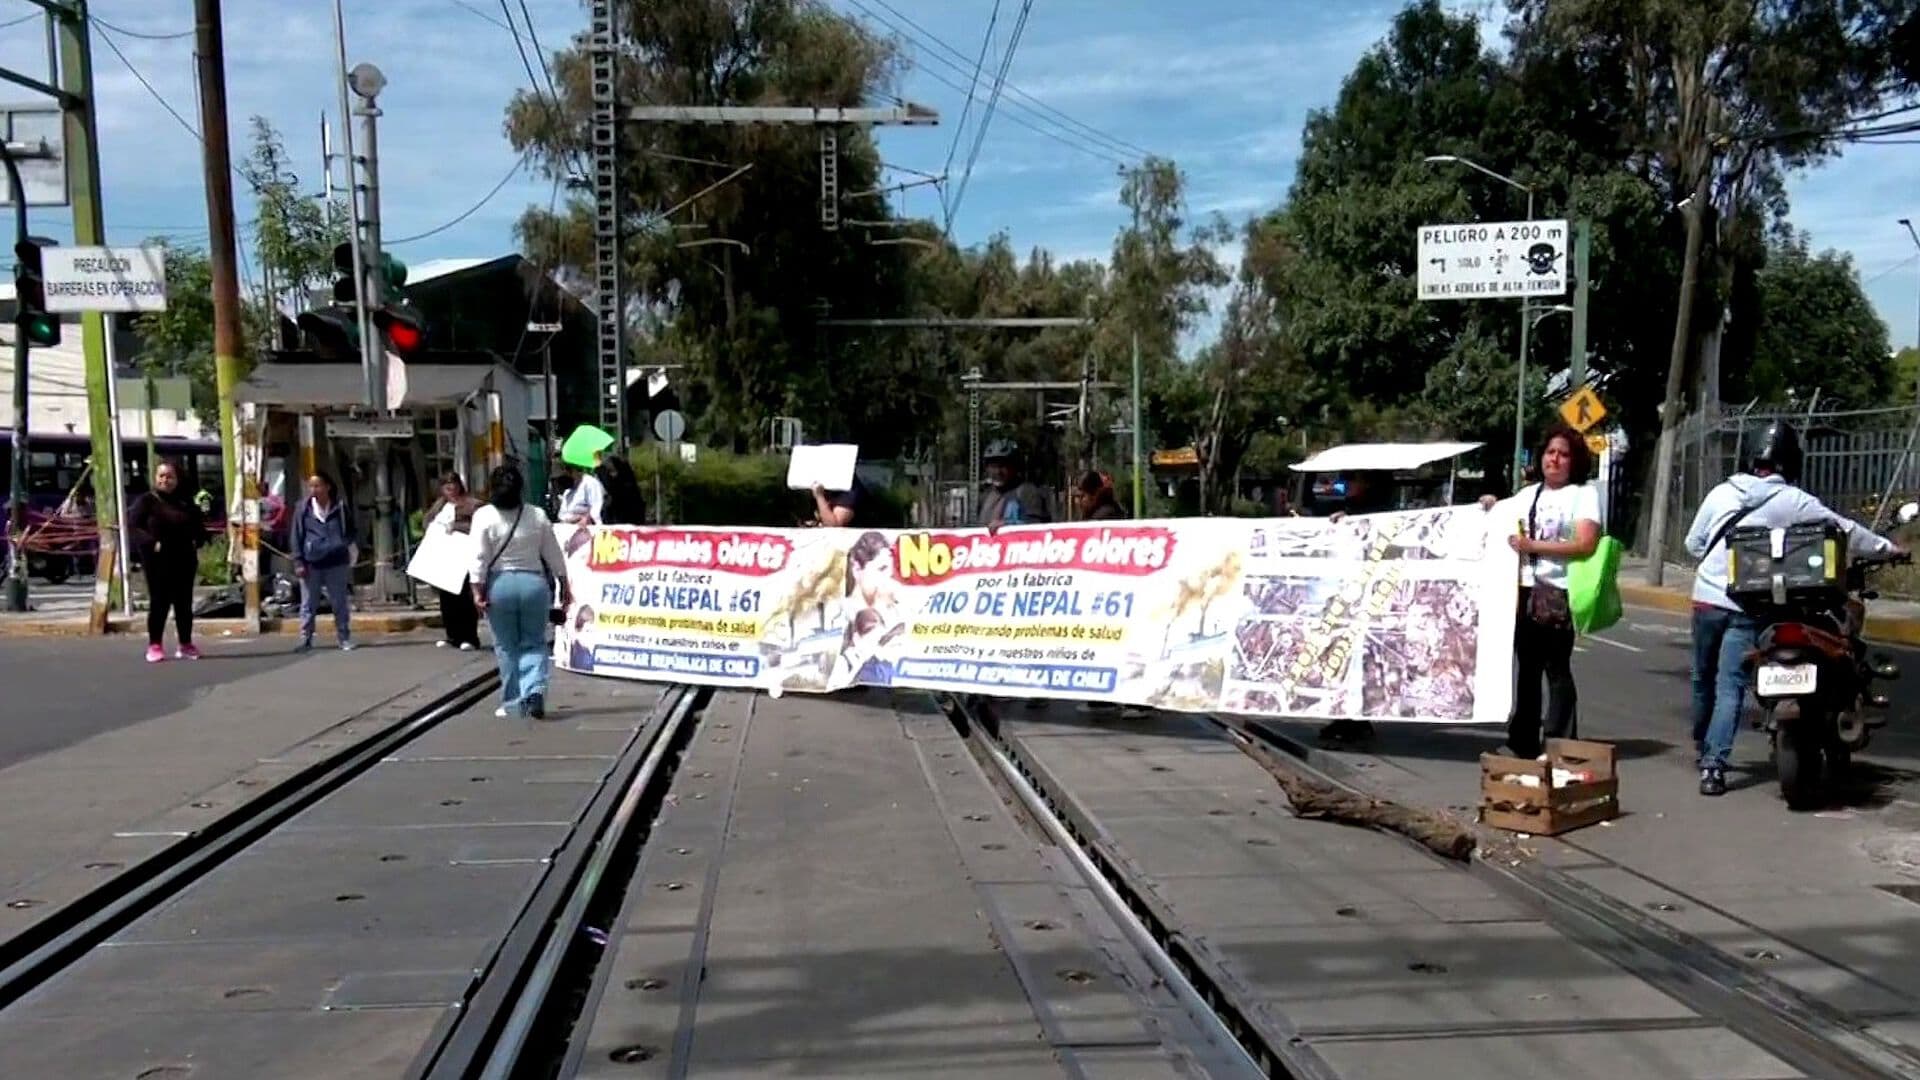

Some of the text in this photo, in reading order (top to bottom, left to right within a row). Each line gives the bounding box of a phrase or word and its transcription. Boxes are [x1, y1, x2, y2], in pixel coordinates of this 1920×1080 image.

[1424, 226, 1562, 244] PELIGRO A 200 m
[47, 282, 94, 296] BARRERAS
[97, 281, 109, 296] EN
[1489, 281, 1498, 292] DE
[1503, 281, 1523, 291] ALTA
[593, 529, 620, 565] No
[656, 534, 712, 562] malos
[717, 536, 786, 568] olores
[898, 532, 952, 577] No
[1004, 531, 1078, 566] malos
[1081, 529, 1168, 567] olores
[638, 572, 654, 582] por
[657, 570, 668, 582] la
[976, 572, 1073, 589] por la fabrica
[601, 584, 761, 613] FRIO DE NEPAL #61
[920, 590, 1135, 618] RIO DE NEPAL #61
[669, 617, 714, 632] problemas
[717, 618, 728, 633] de
[731, 619, 756, 635] salud
[911, 623, 929, 635] Nos
[954, 623, 1012, 638] generando
[1013, 623, 1068, 640] problemas
[1071, 625, 1086, 640] de
[1090, 625, 1123, 641] salud
[662, 637, 699, 649] nuestros
[932, 644, 975, 656] nosotros
[977, 647, 985, 658] y
[999, 647, 1044, 659] nuestros
[1081, 649, 1096, 661] de
[709, 657, 724, 672] DE
[1051, 670, 1071, 686] DE
[1072, 671, 1112, 689] CHILE
